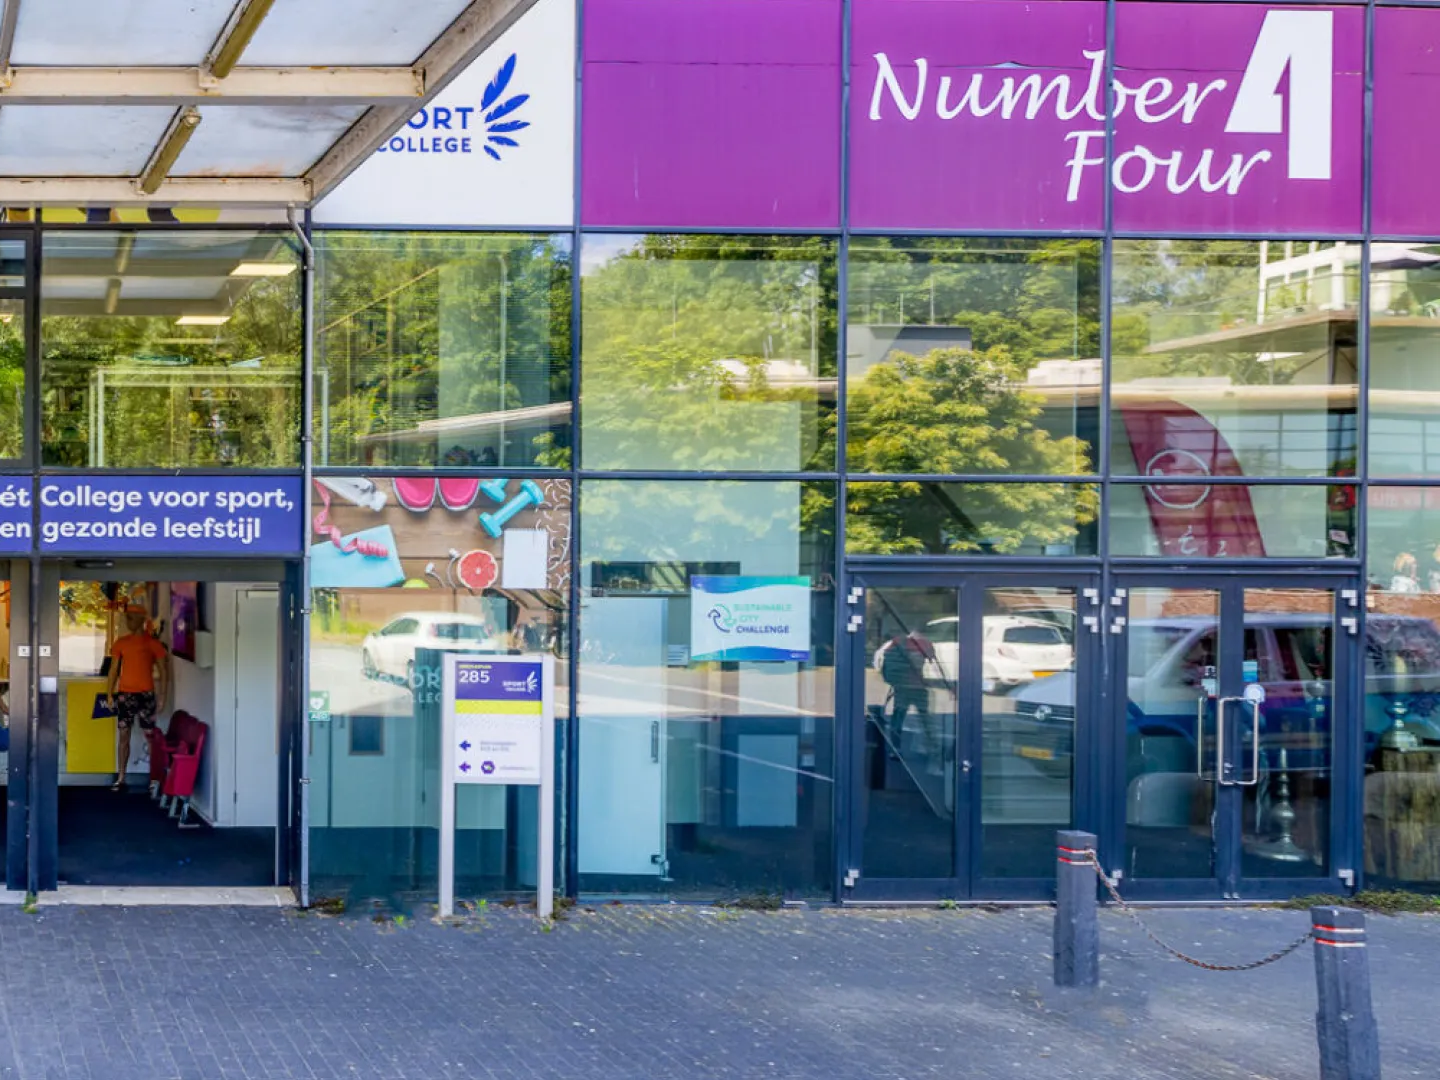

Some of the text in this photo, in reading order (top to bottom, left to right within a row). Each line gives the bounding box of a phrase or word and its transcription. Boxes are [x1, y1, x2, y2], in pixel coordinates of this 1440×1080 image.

[868, 49, 1228, 124] Number
[407, 107, 475, 130] ORT
[1064, 129, 1272, 202] Four
[40, 484, 143, 512] College
[148, 490, 210, 507] voor
[215, 488, 294, 513] sport,
[42, 517, 157, 543] gezonde
[163, 517, 261, 544] leefstijl
[735, 625, 790, 634] CHALLENGE
[459, 670, 491, 683] 285
